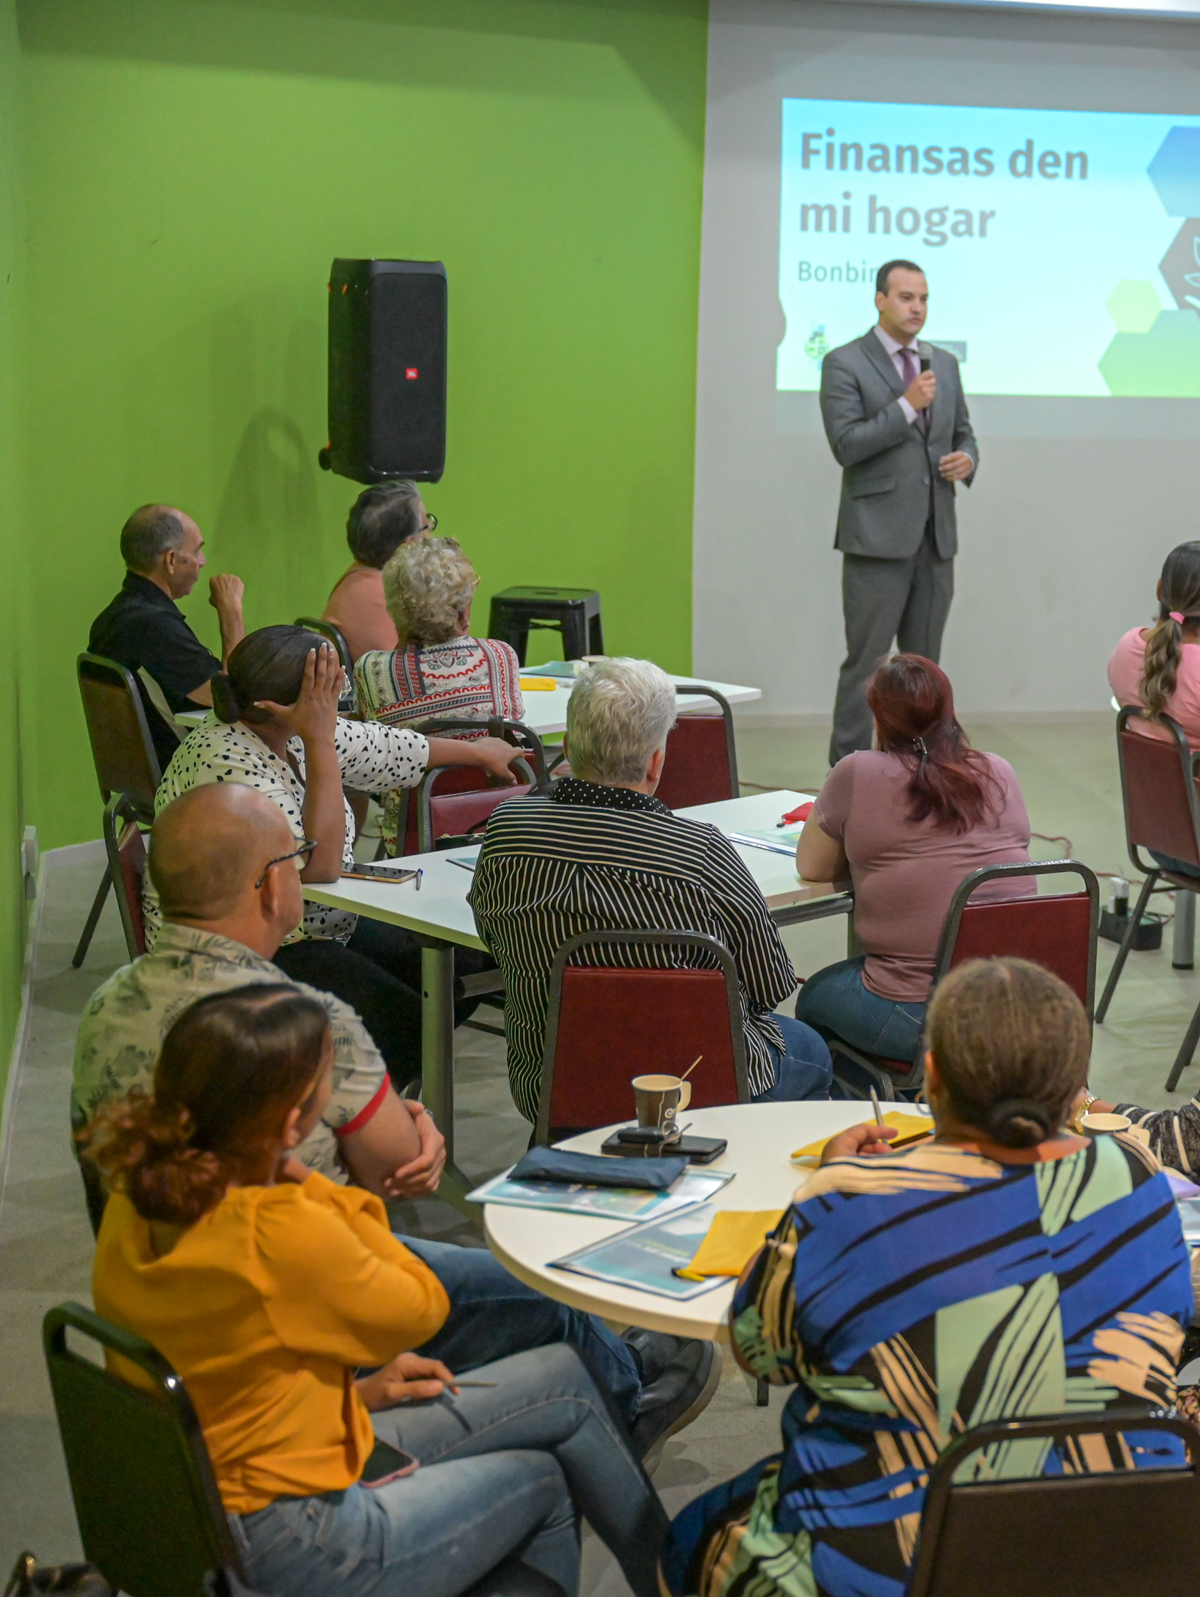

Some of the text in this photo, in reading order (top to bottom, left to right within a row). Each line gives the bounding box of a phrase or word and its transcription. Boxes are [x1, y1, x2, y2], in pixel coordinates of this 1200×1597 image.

[801, 127, 1089, 180] Finansas den
[800, 190, 996, 247] mi hogar
[798, 260, 879, 283] Bonbin
